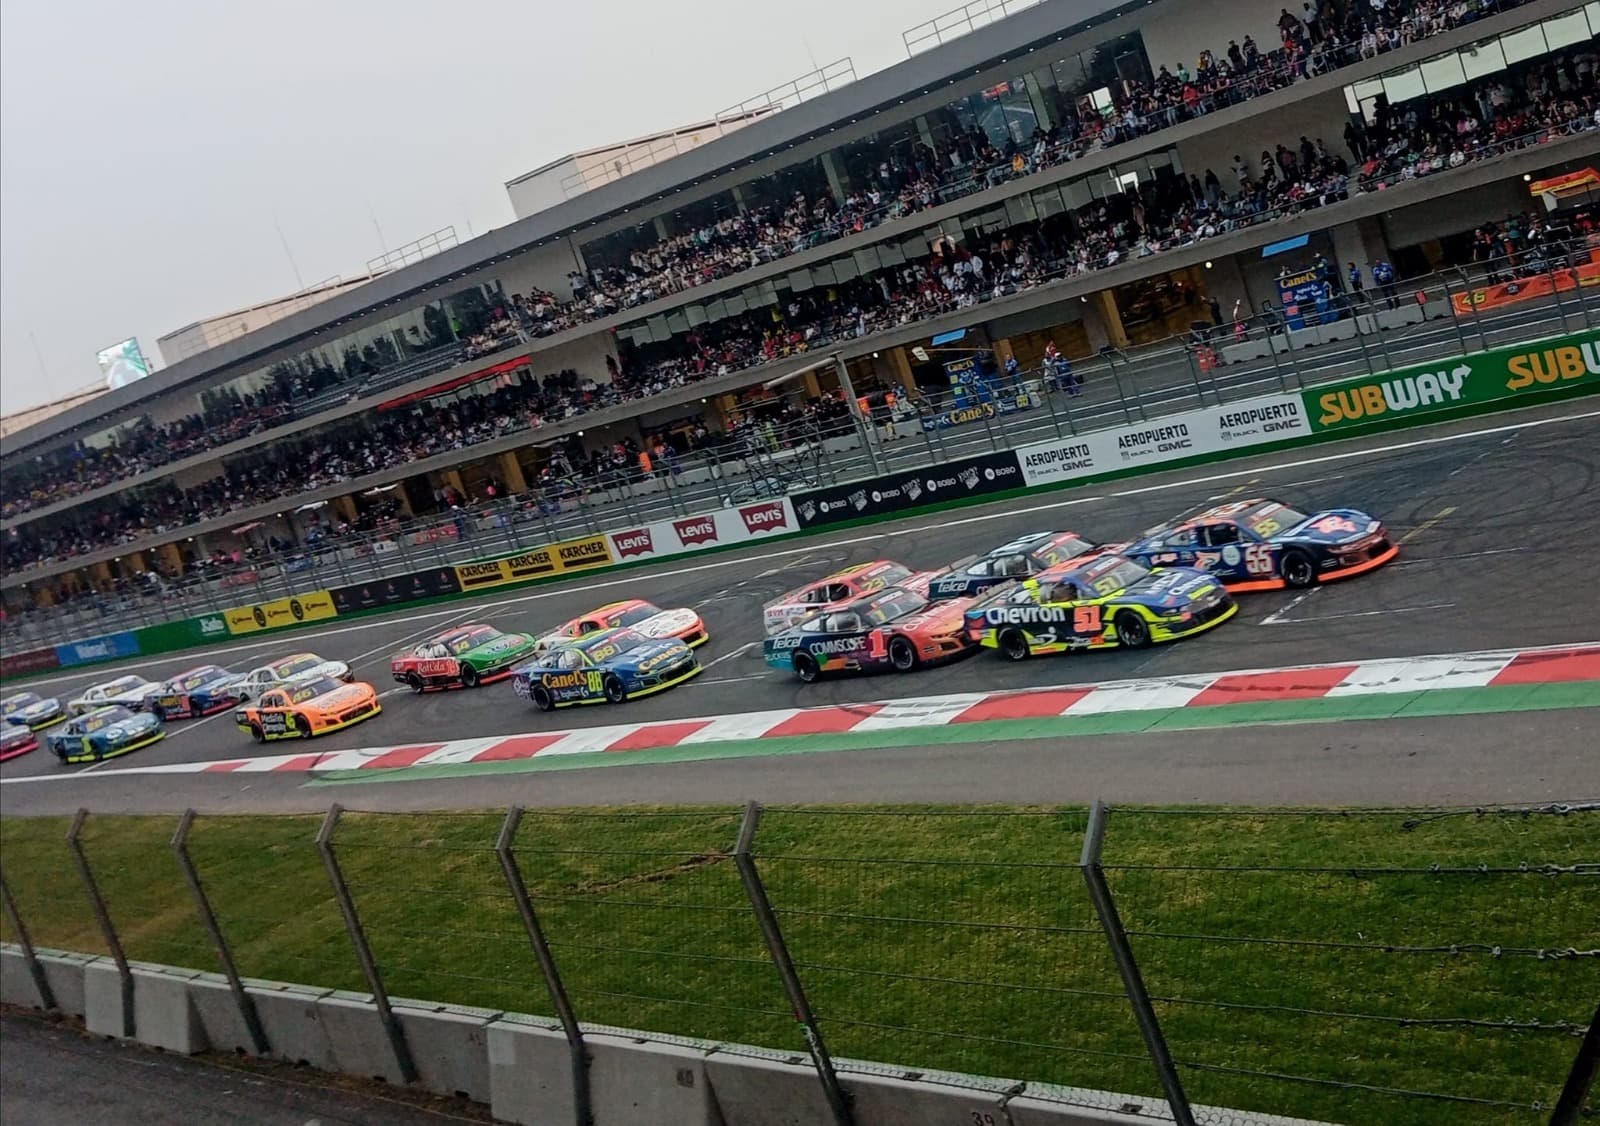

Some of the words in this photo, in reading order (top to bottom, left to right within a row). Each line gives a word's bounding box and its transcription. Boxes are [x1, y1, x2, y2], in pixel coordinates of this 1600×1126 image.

[1280, 271, 1318, 288] Canel's
[1318, 363, 1473, 426] SUBWAY
[1219, 402, 1298, 429] AEROPUERTO
[1263, 418, 1301, 433] GMC
[1118, 423, 1188, 449] AEROPUERTO
[1157, 438, 1192, 453] GMC
[1025, 443, 1090, 468] AEROPUERTO
[1062, 458, 1094, 472] GMC
[995, 466, 1016, 476] BOBO
[937, 477, 956, 488] BOBO
[1254, 517, 1280, 538] 55
[1245, 545, 1273, 574] 55
[1093, 578, 1119, 595] 51
[985, 605, 1065, 625] Chevron
[1073, 605, 1103, 633] 51
[592, 644, 615, 662] 88
[809, 636, 867, 656] COMMSCOPE
[868, 628, 887, 658] 1
[541, 669, 588, 690] Canel's
[587, 670, 604, 692] 88
[293, 688, 312, 703] 46
[971, 1111, 996, 1126] 39
